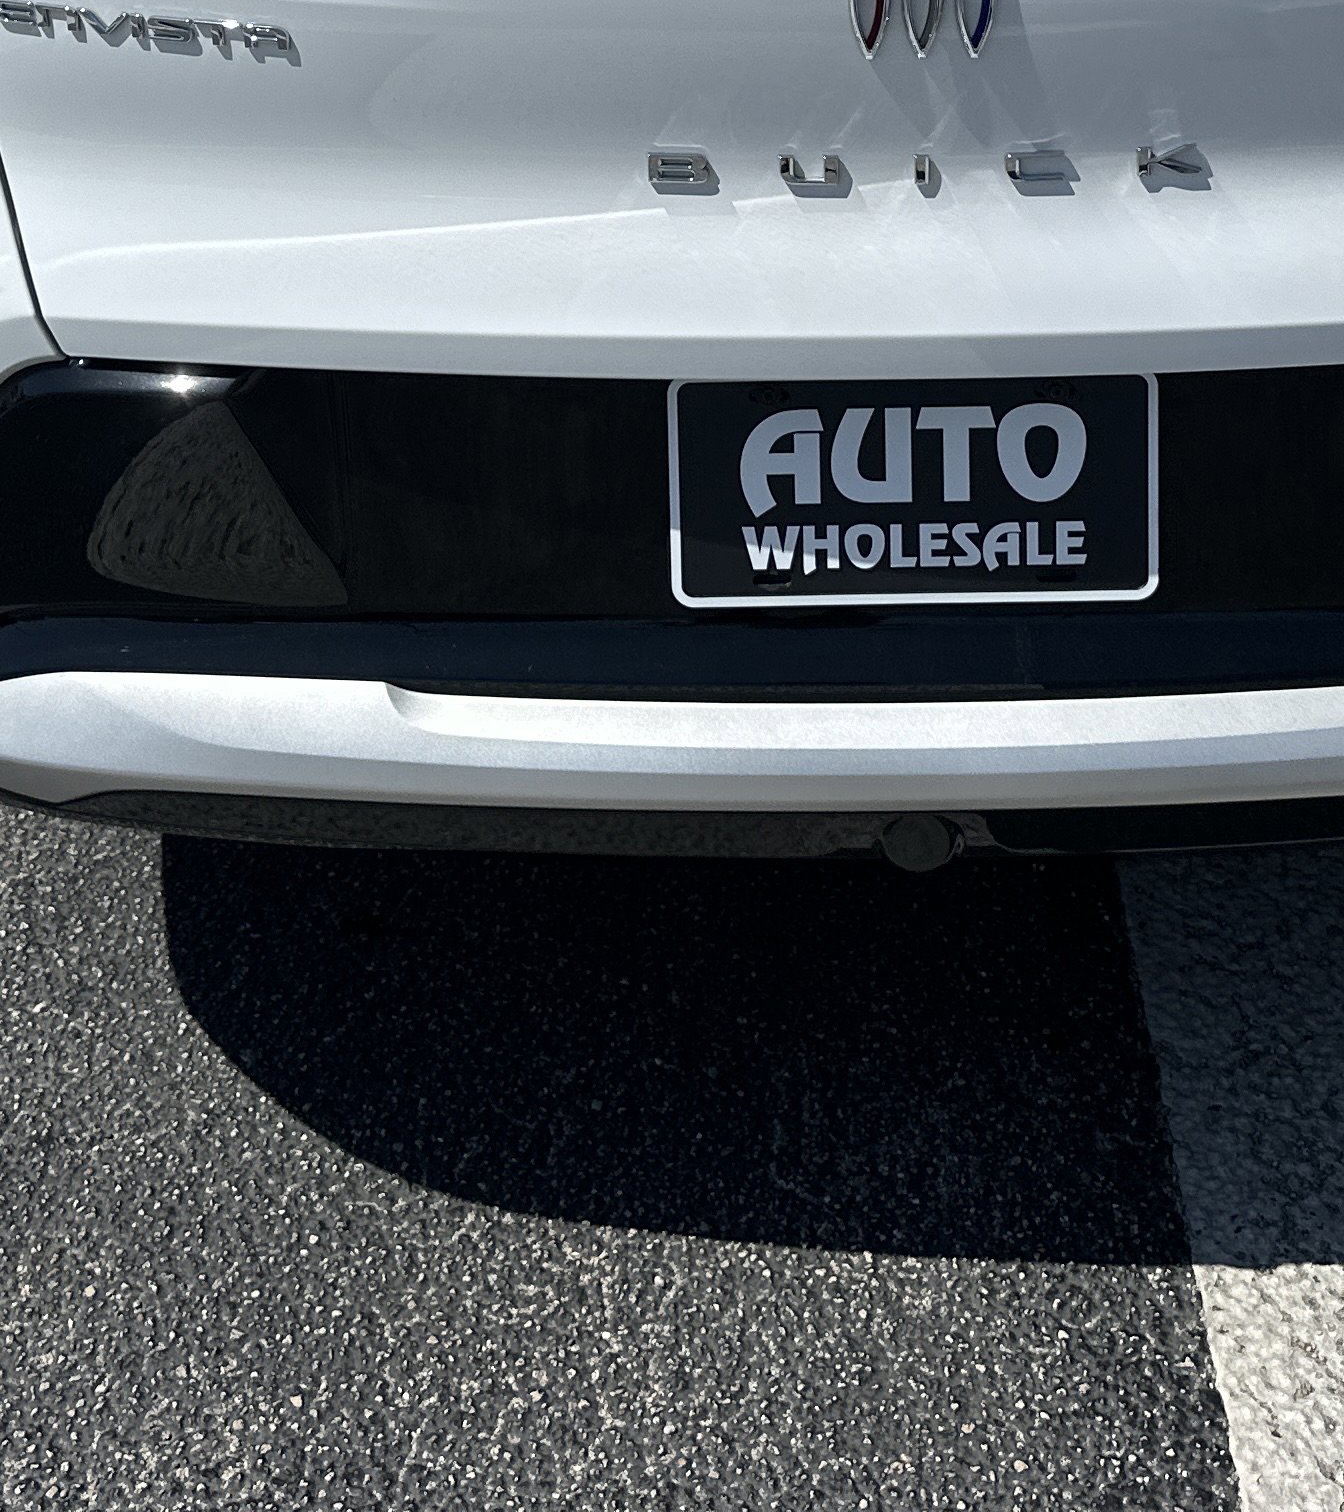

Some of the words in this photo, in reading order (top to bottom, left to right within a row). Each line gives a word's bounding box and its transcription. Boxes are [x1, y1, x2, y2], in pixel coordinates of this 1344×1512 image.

[648, 143, 1202, 185] BUICK
[740, 403, 1087, 518] AUTO
[741, 520, 1087, 575] WHOLESALE
